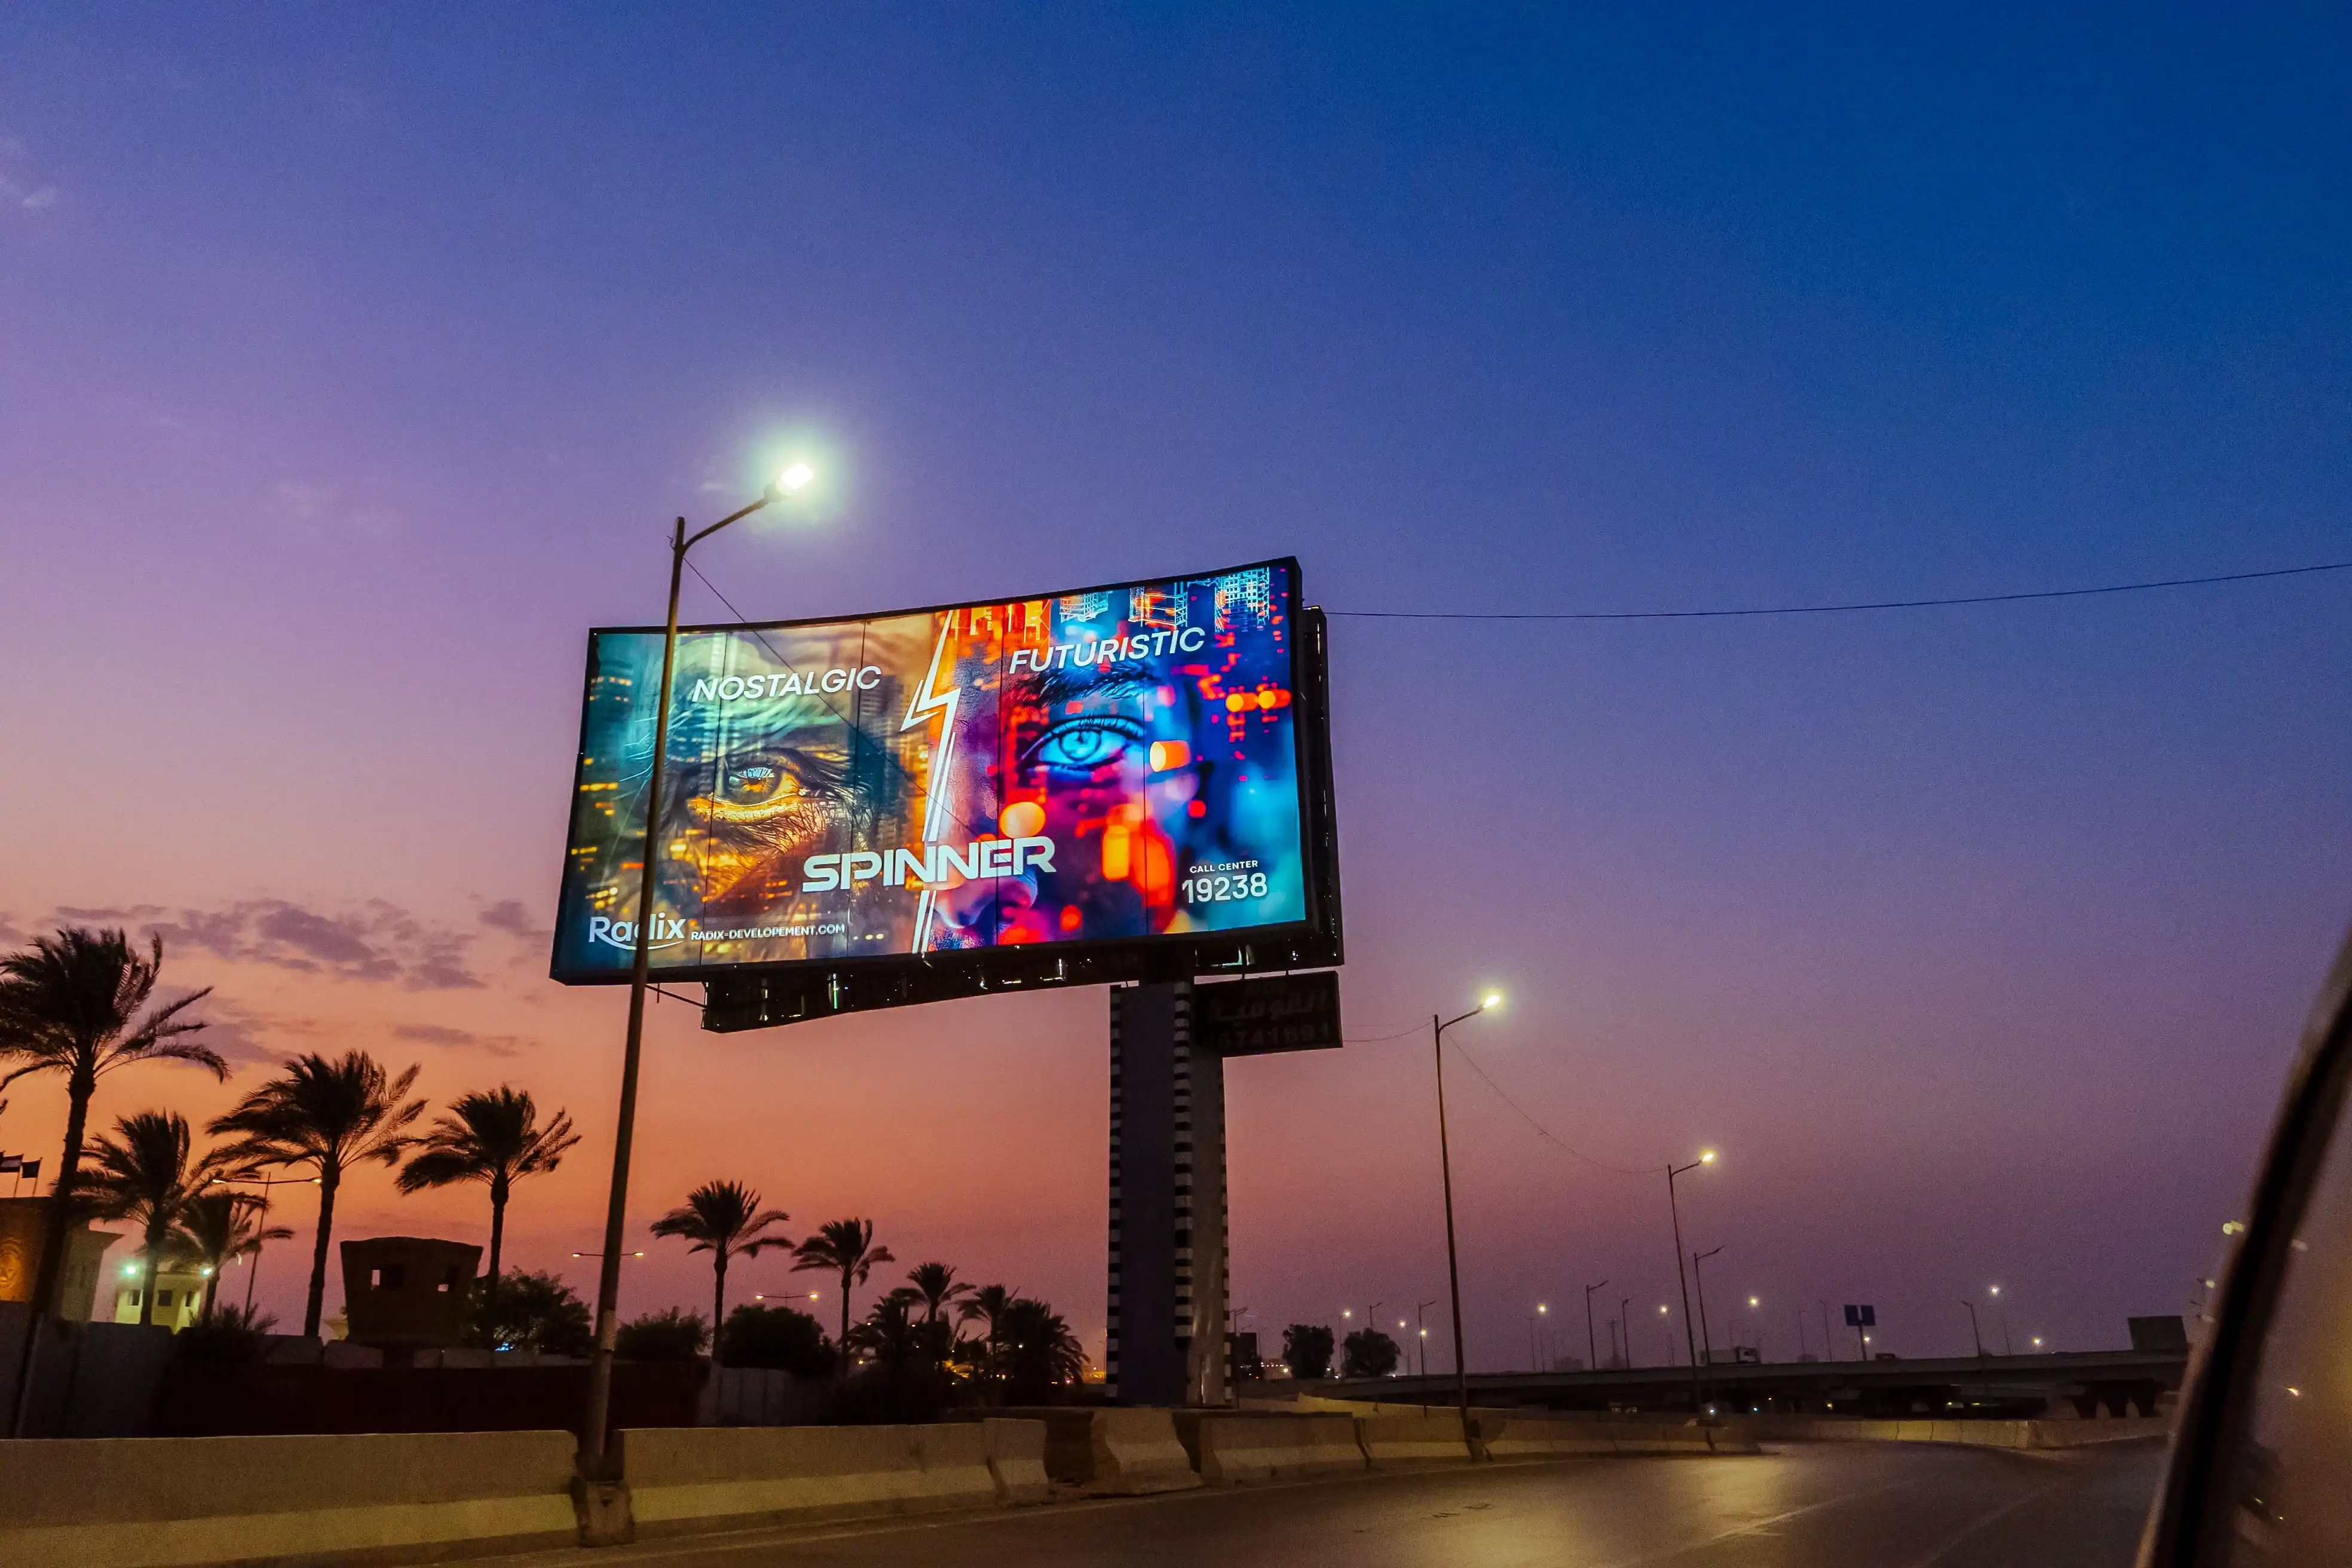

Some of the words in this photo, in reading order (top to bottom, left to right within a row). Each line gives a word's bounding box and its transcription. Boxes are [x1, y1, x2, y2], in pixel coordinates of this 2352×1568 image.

[1009, 627, 1206, 675] FUTURISTIC
[691, 666, 883, 702] NOSTALGIC
[802, 836, 1057, 893] SPINNER
[1189, 864, 1215, 874] CALL
[1218, 860, 1258, 871] CENTER
[1181, 872, 1267, 904] 19238
[691, 923, 845, 941] RADIX-DEVELOPEMENT.COM
